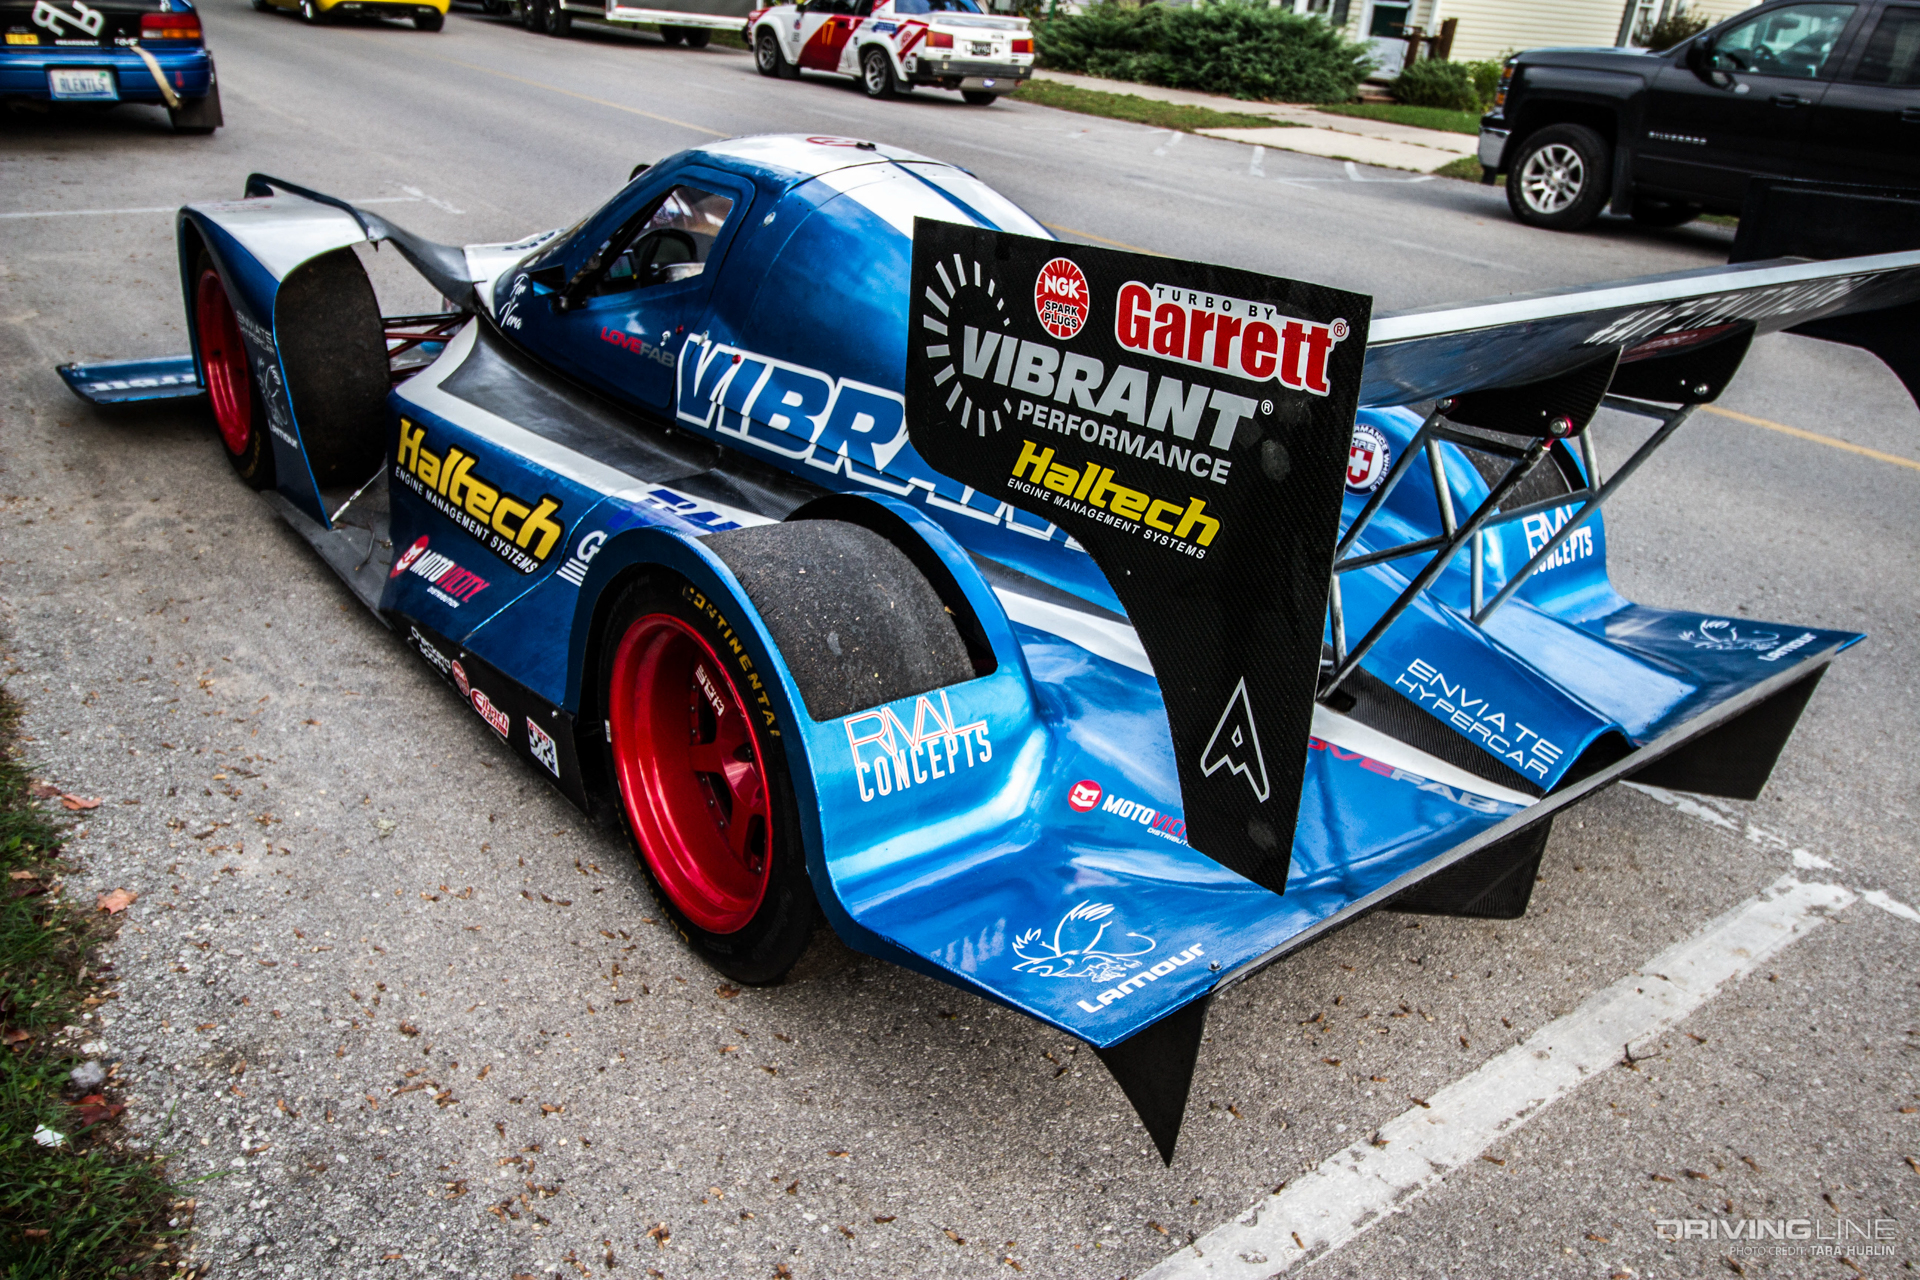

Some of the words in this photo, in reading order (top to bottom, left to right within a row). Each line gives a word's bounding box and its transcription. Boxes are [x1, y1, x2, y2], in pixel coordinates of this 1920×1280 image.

[1044, 273, 1081, 300] NGK
[1044, 311, 1078, 329] PLUGS
[1045, 300, 1079, 317] SPARK
[1156, 287, 1232, 312] TURBO
[1248, 304, 1274, 321] BY
[600, 326, 676, 368] LOVEFAB
[1016, 399, 1232, 485] PERFORMANCE
[395, 467, 423, 495] ENGINE
[425, 489, 490, 541] MANAGEMENT
[490, 535, 539, 574] SYSTEMS
[397, 418, 562, 561] Haltech
[1007, 477, 1051, 501] ENGINE
[1053, 494, 1141, 535] MANAGEMENT
[1143, 528, 1207, 560] SYSTEMS
[1011, 439, 1221, 547] Haltech
[409, 549, 490, 603] MOTOVICITY
[843, 690, 988, 767] RIVAL
[855, 724, 993, 803] CONCEPTS
[1394, 673, 1550, 780] HYPERCAR
